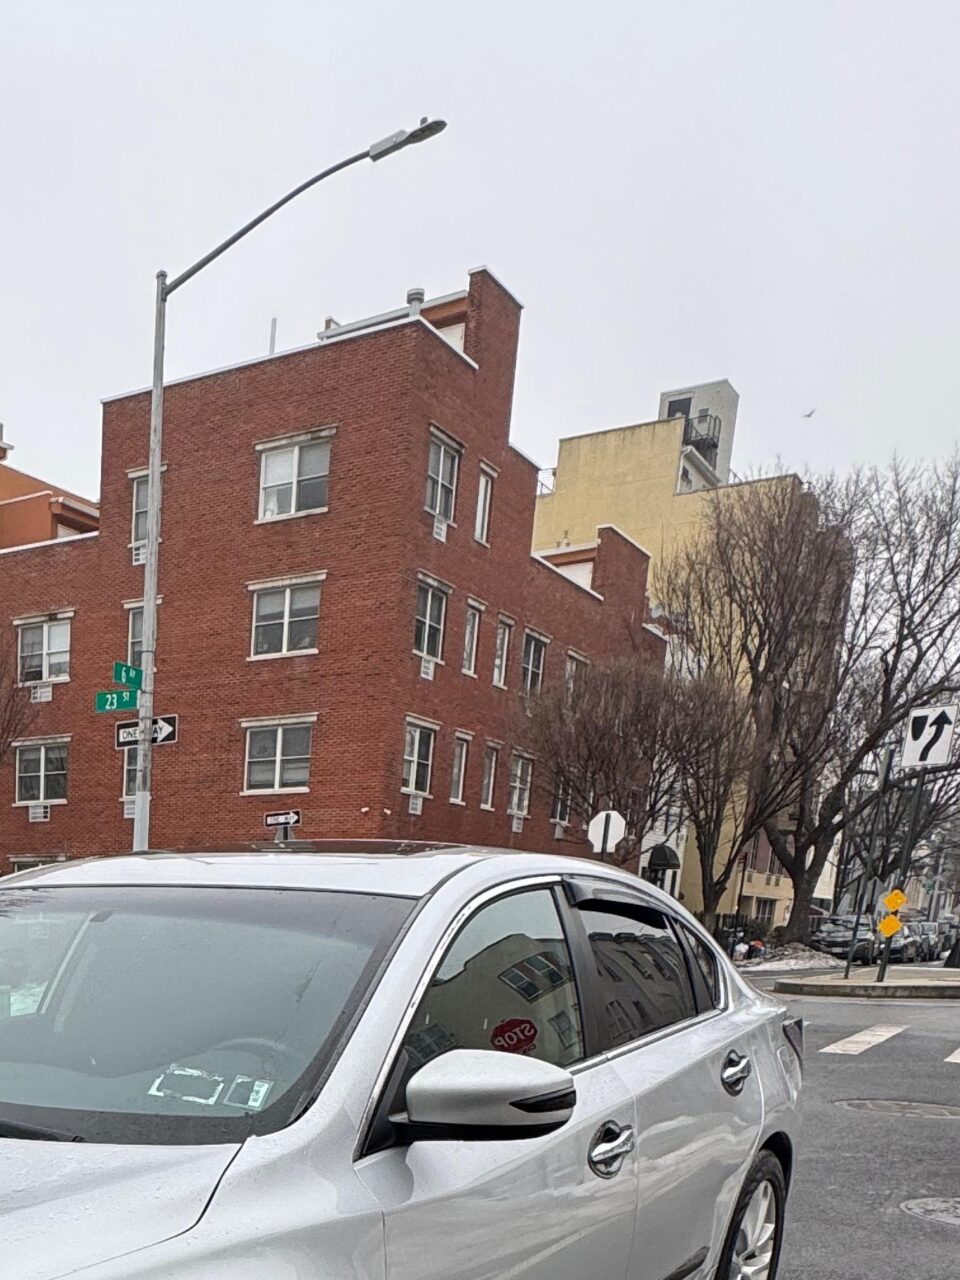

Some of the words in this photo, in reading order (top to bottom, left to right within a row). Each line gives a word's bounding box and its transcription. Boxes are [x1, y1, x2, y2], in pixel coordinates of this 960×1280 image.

[121, 666, 127, 683] 6
[105, 693, 117, 710] 23
[122, 691, 130, 702] ST
[122, 728, 138, 740] ONE
